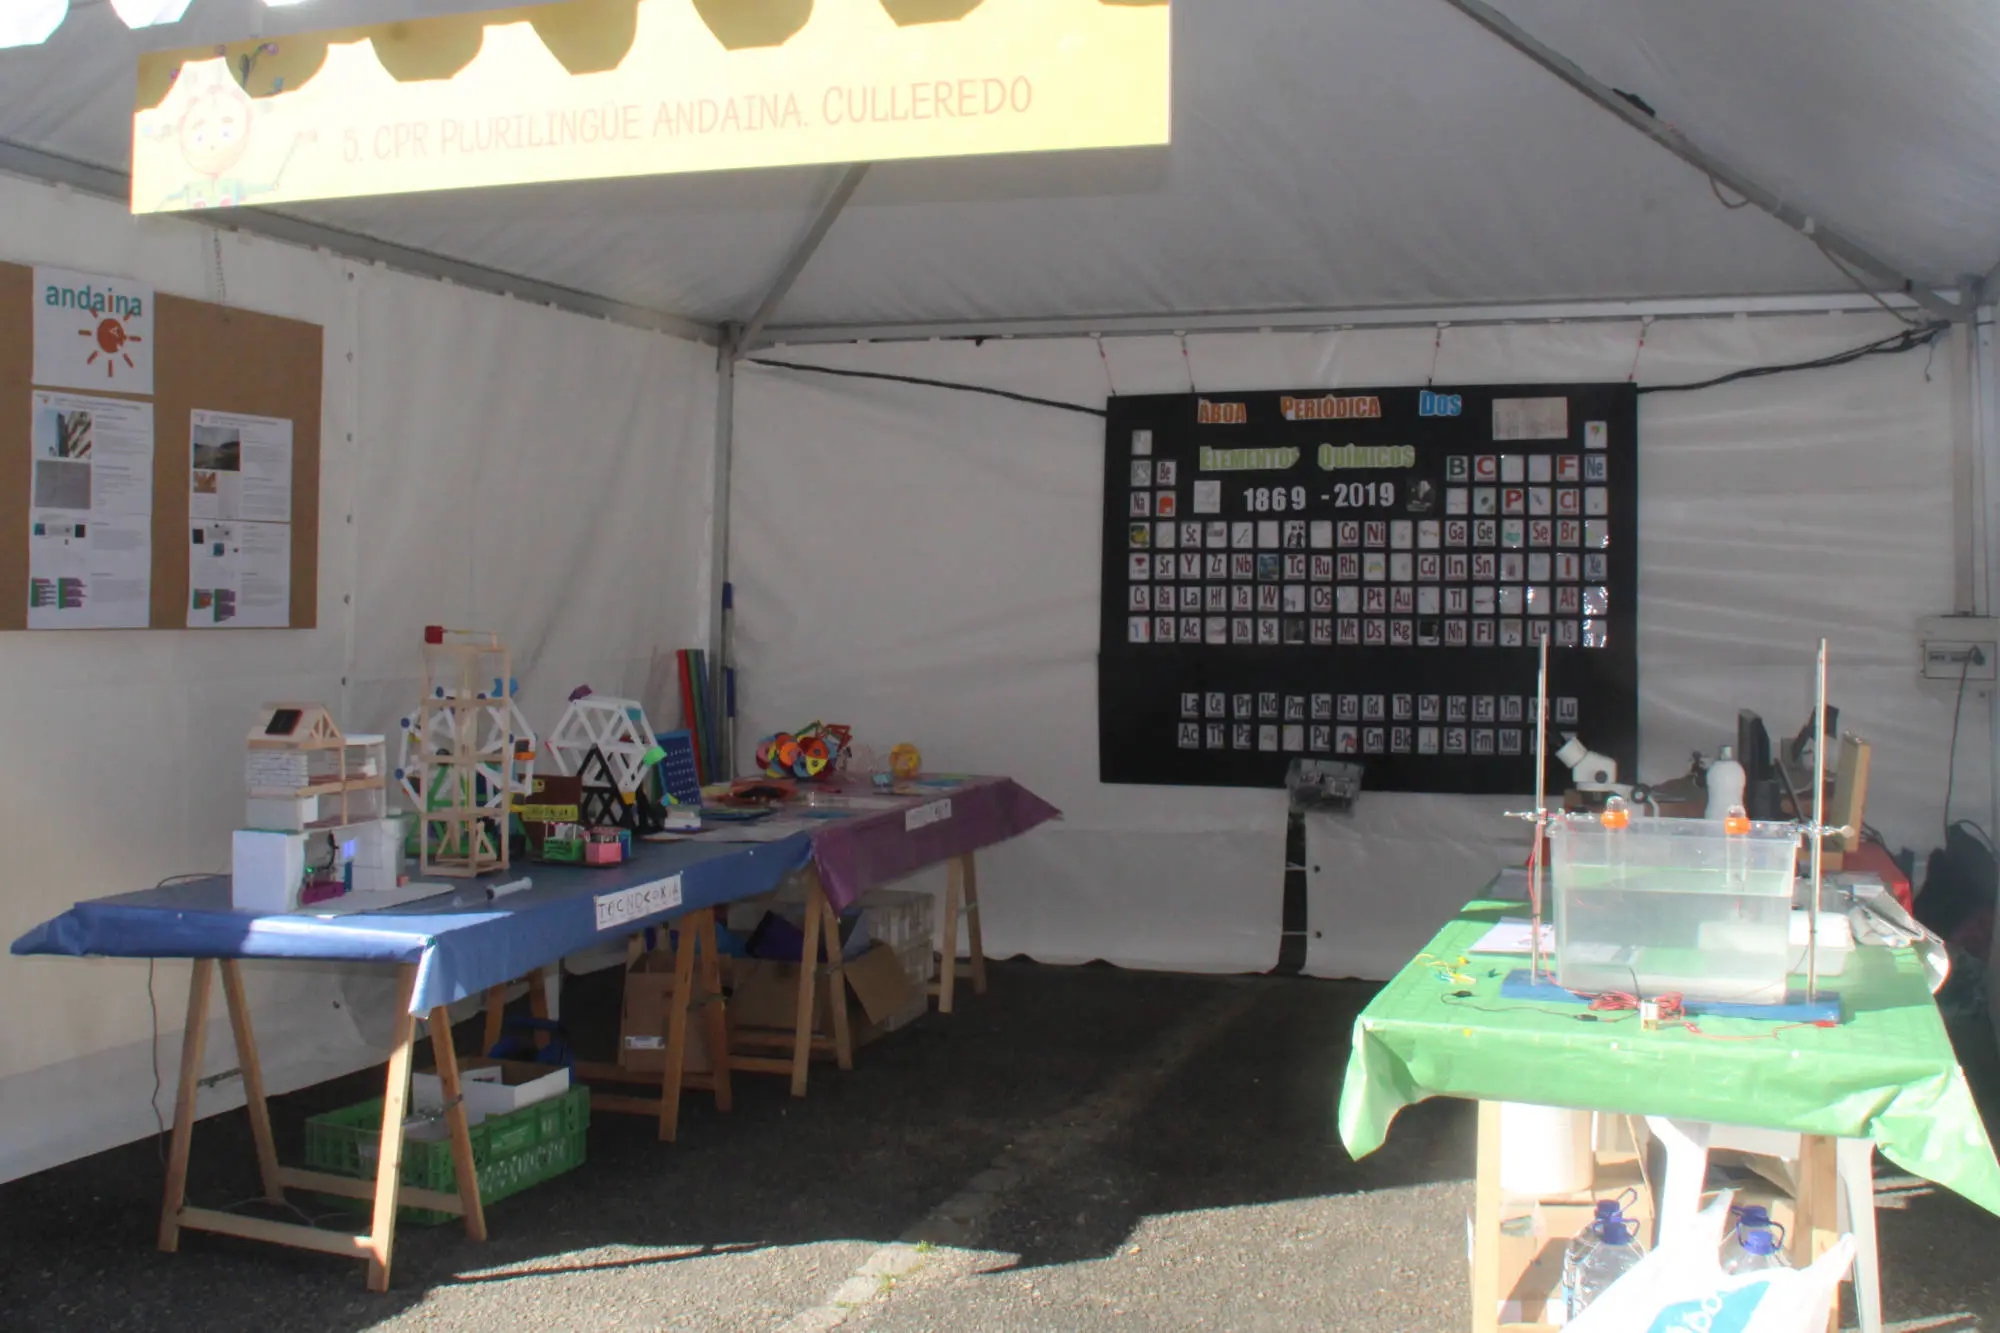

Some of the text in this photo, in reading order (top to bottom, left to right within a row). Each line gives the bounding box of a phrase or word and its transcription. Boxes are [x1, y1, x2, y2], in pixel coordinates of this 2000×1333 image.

[343, 75, 1034, 164] 5. CPR PLURILINGÜE ANDAINA. CULLEREDO
[45, 284, 142, 317] andaina
[1159, 462, 1171, 480] Be
[1450, 457, 1465, 475] B
[1477, 457, 1495, 475] C
[1558, 456, 1576, 474] F
[1586, 457, 1603, 476] Ne
[1133, 494, 1146, 511] Na
[1243, 486, 1306, 512] 1869
[1505, 489, 1521, 508] P
[1560, 490, 1577, 508] Cl
[1341, 523, 1357, 540] Co
[1367, 523, 1385, 541] Ni
[1449, 523, 1465, 540] Ga
[1477, 522, 1493, 539] Ge
[1533, 521, 1548, 541] Se
[1561, 521, 1576, 541] Br
[1184, 554, 1195, 573] Y
[1235, 556, 1251, 573] Nb
[1289, 555, 1304, 573] Tc
[1314, 557, 1330, 575] Ru
[1340, 555, 1356, 573] Rh
[1420, 557, 1436, 574] Cd
[1450, 556, 1464, 574] In
[1475, 556, 1491, 574] Sn
[1184, 588, 1198, 606] La
[1262, 585, 1276, 604] W
[1314, 588, 1330, 606] Os
[1367, 589, 1382, 607] Pt
[1394, 589, 1410, 606] Au
[1183, 619, 1197, 637] Ac
[1314, 620, 1331, 638] Hs
[1366, 622, 1382, 639] Ds
[1393, 622, 1409, 640] Rg
[1184, 695, 1199, 712] La
[1340, 696, 1356, 714] Eu
[1559, 700, 1575, 717] Lu
[1180, 724, 1198, 742] Ac
[1446, 727, 1462, 745] Es
